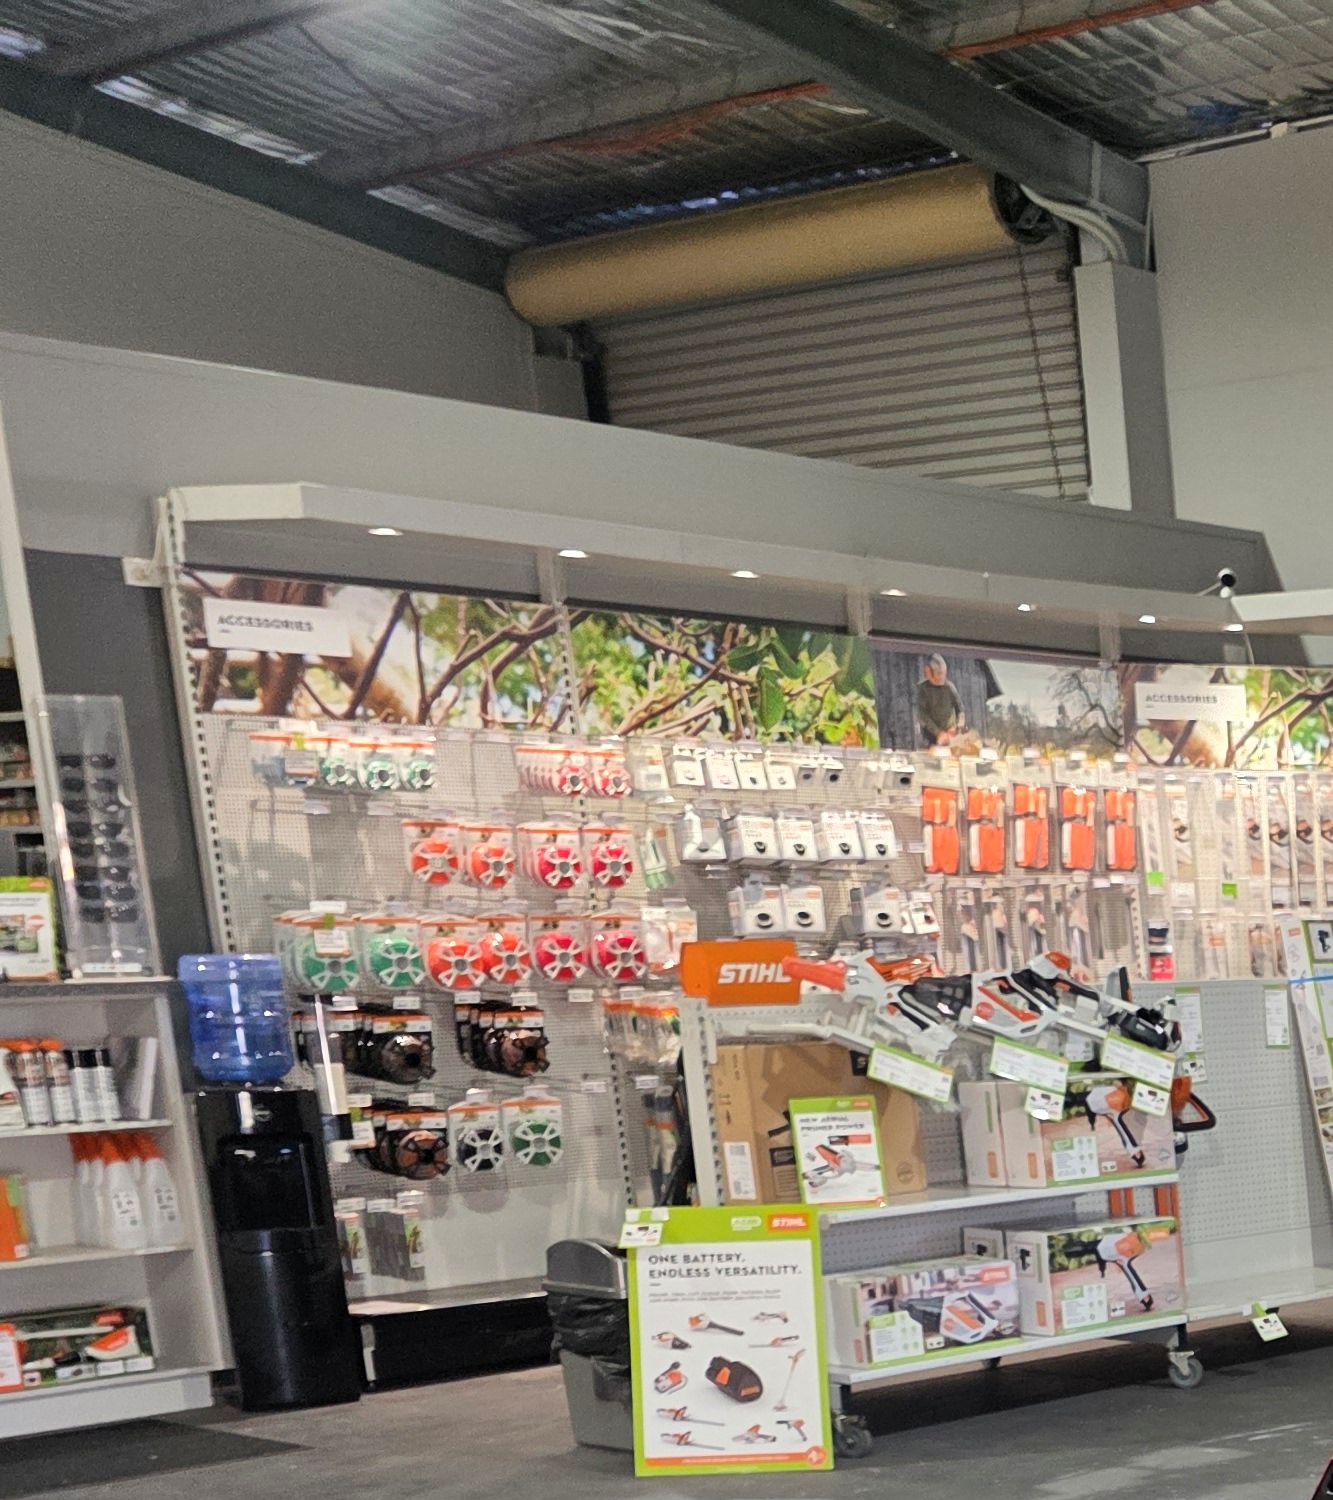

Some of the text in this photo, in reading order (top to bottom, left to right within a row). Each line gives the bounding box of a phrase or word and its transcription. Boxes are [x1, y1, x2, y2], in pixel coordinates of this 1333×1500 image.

[217, 614, 314, 632] ACCESSORIES
[1145, 693, 1218, 704] ACCESSORIES
[718, 961, 793, 985] STIHL
[648, 1252, 746, 1265] ONE BATTERY.
[649, 1264, 802, 1280] ENDLESS VERSATILITY.
